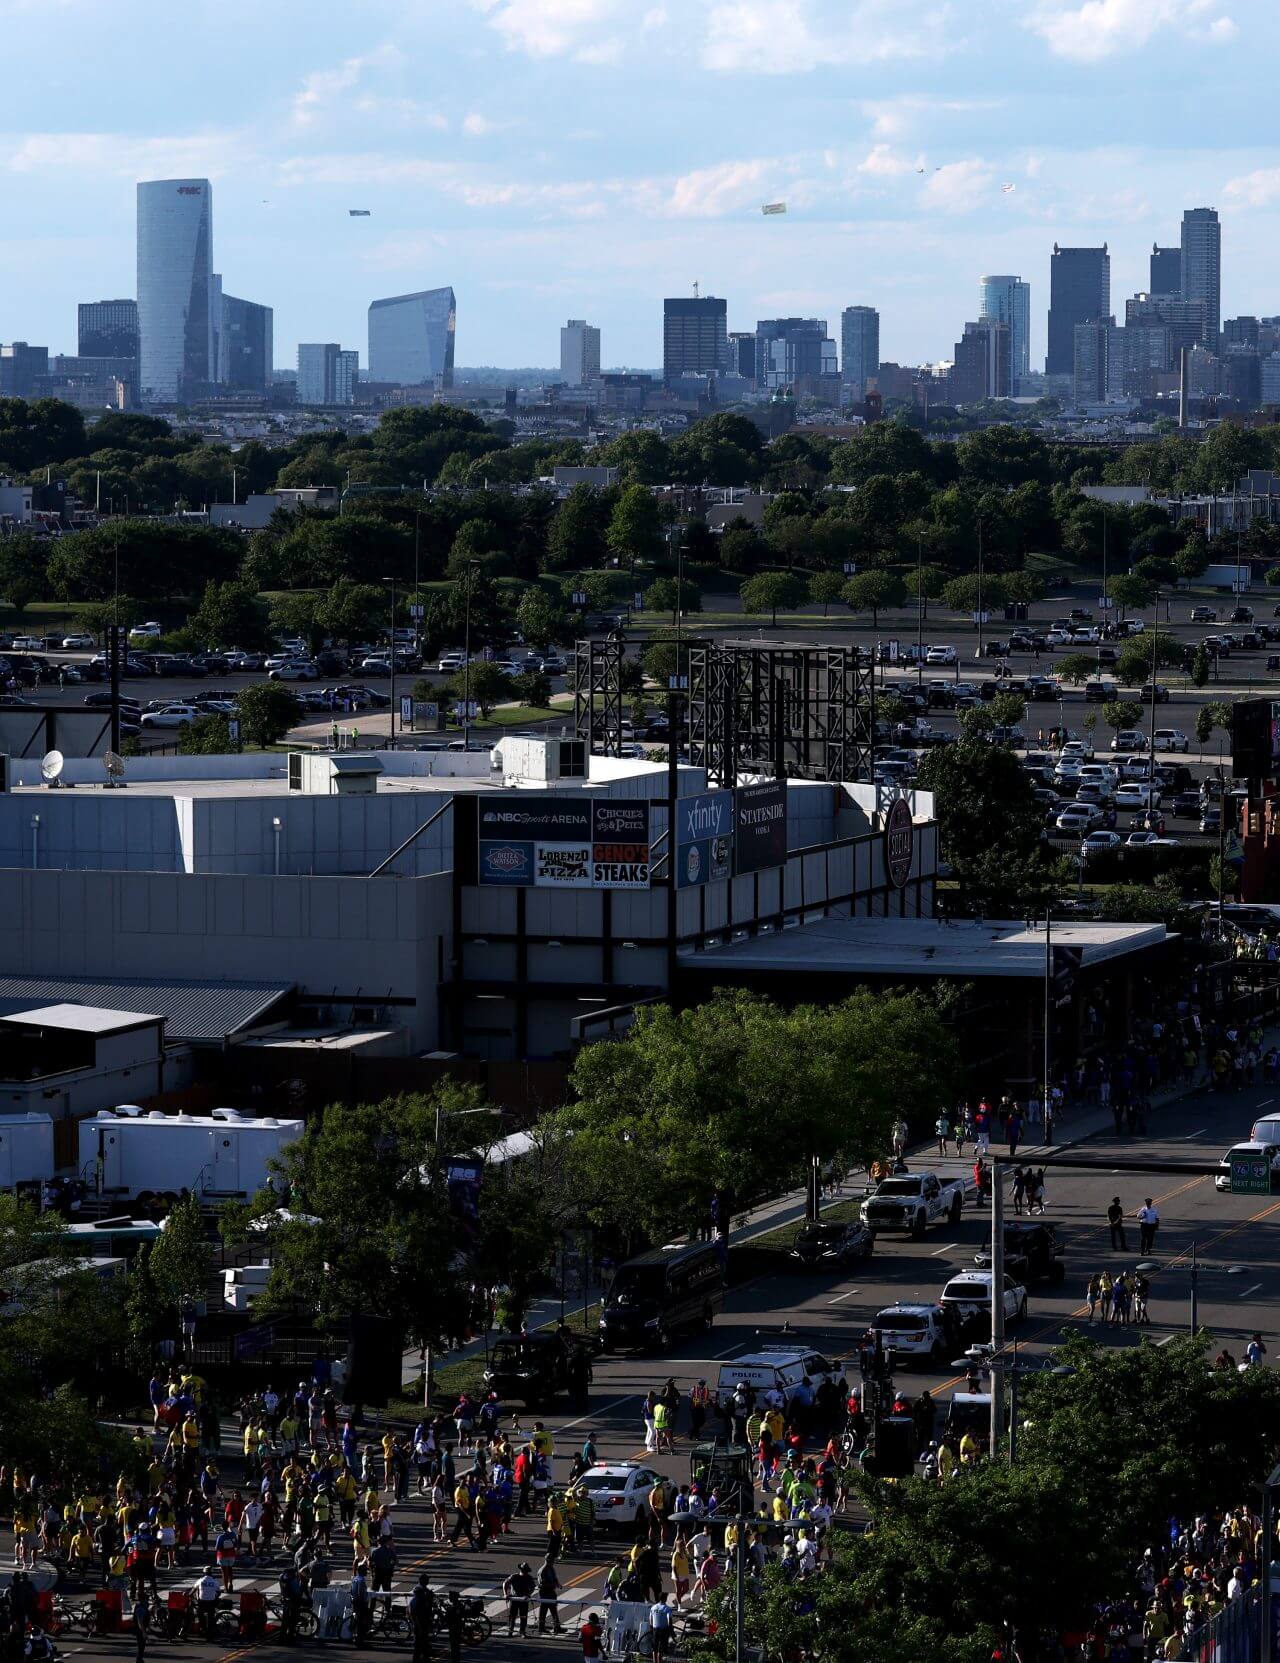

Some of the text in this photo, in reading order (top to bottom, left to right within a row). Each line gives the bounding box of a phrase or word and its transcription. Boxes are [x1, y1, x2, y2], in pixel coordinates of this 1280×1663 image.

[497, 814, 521, 822] NBC
[551, 815, 588, 824] ARENA
[688, 800, 723, 839] xfinity
[740, 803, 784, 825] STATESIDE
[538, 849, 589, 861] LORENZO
[593, 846, 648, 862] GENO'S
[539, 868, 589, 878] PIZZA
[594, 864, 648, 882] STEAKS
[1237, 1166, 1246, 1175] 76
